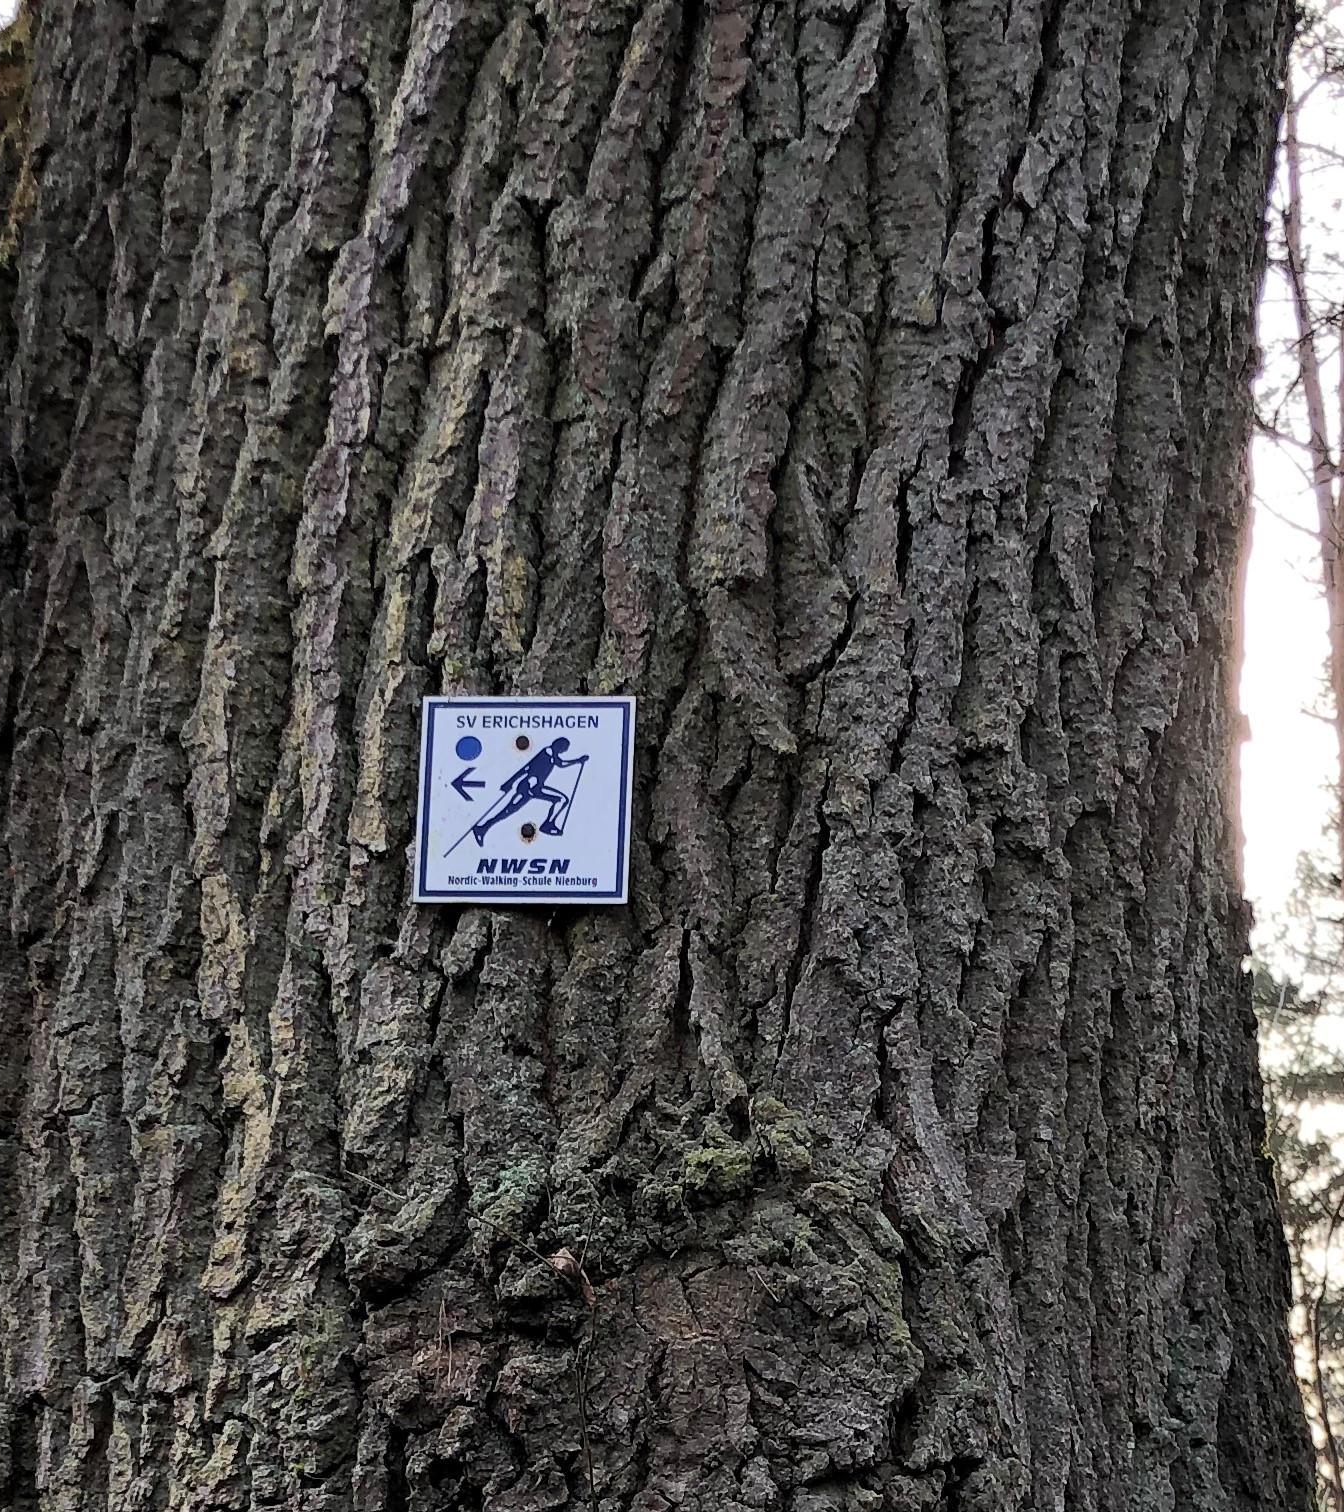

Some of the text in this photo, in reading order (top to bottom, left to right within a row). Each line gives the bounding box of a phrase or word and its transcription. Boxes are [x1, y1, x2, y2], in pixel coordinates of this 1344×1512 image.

[456, 715, 599, 728] SV ERICHSHAGEN
[476, 858, 571, 874] NWSN
[448, 876, 598, 887] Nordic-Walking-Schule Nienburg
